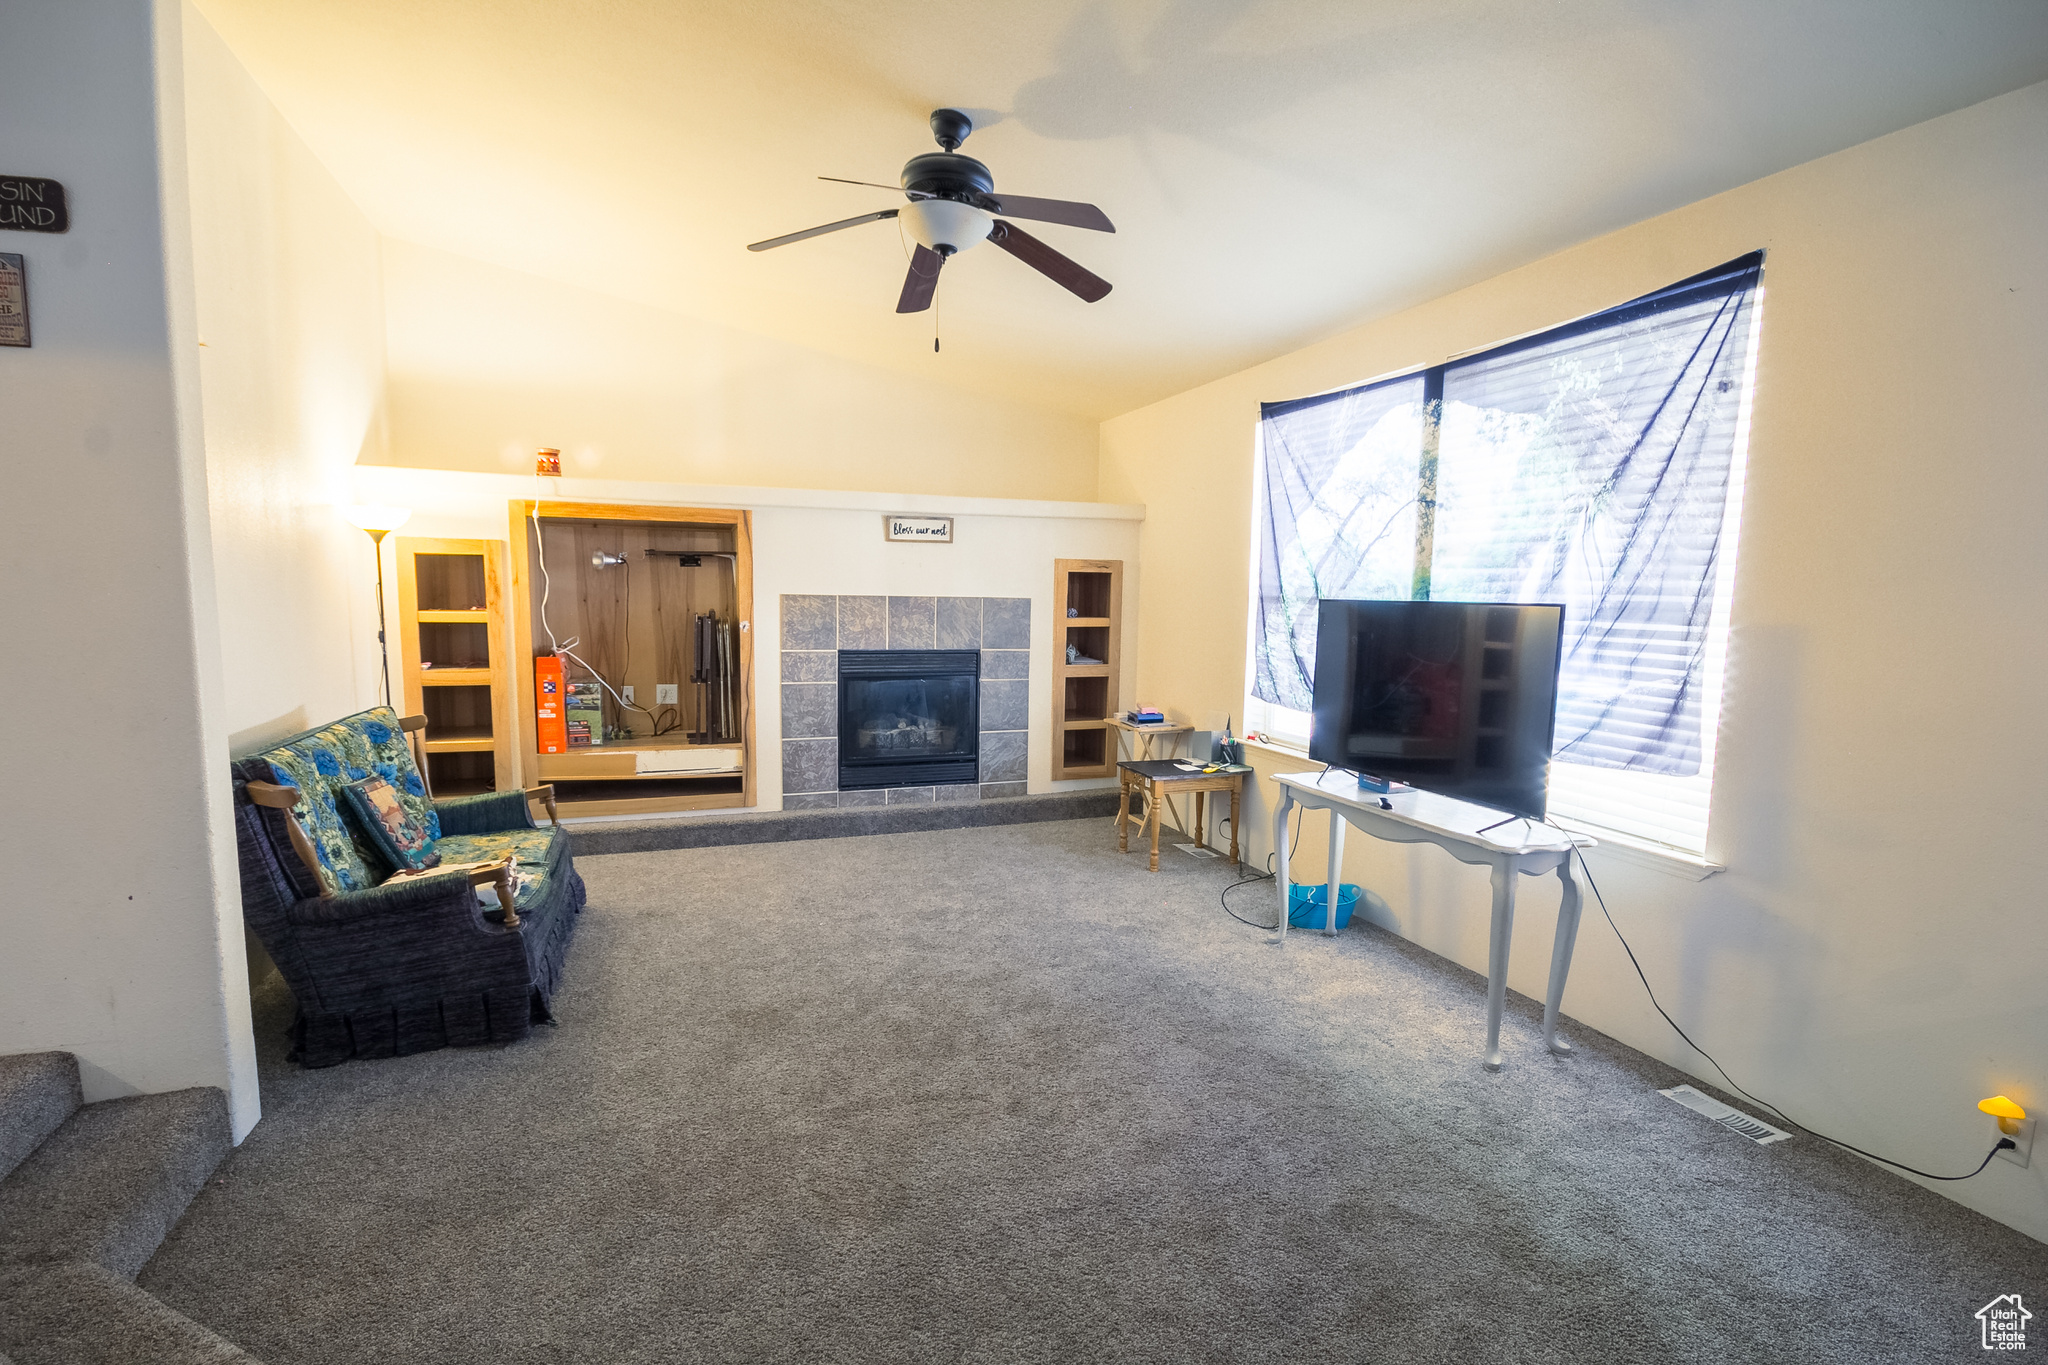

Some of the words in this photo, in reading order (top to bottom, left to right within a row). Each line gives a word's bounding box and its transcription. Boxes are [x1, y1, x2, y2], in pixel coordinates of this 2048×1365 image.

[0, 204, 56, 226] UND
[915, 527, 930, 535] our
[931, 523, 948, 537] nest
